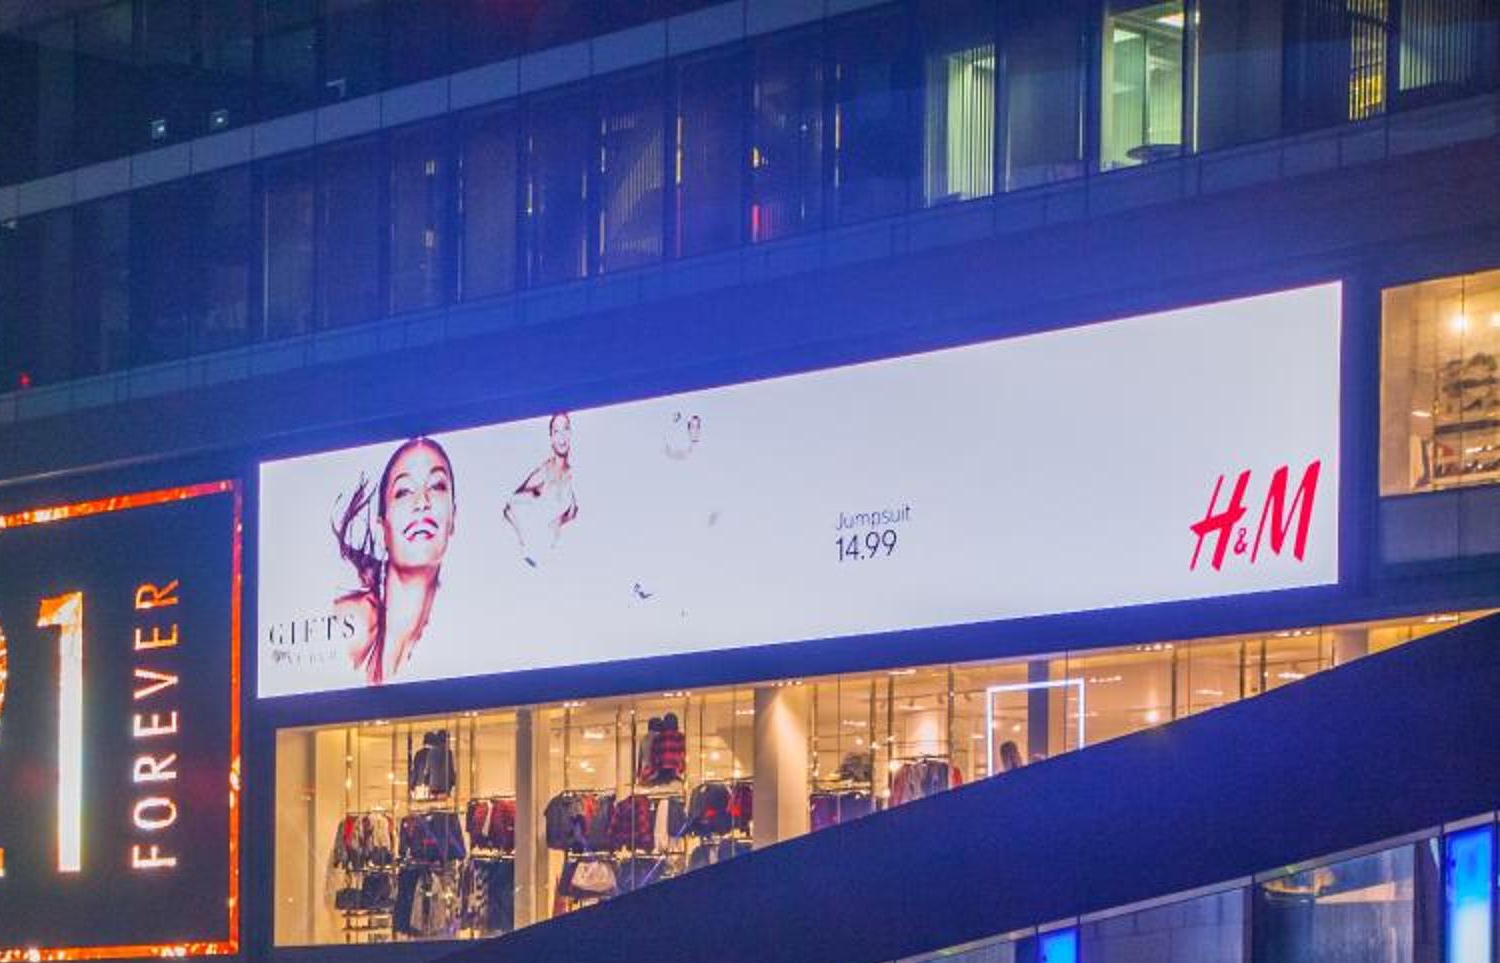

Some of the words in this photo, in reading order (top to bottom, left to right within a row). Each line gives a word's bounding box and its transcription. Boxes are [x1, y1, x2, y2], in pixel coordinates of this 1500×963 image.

[836, 502, 911, 530] Jumpsuit
[1189, 460, 1321, 571] H&M
[836, 529, 897, 562] 14.99
[269, 613, 355, 645] GIFTS
[132, 578, 180, 872] FOREVER
